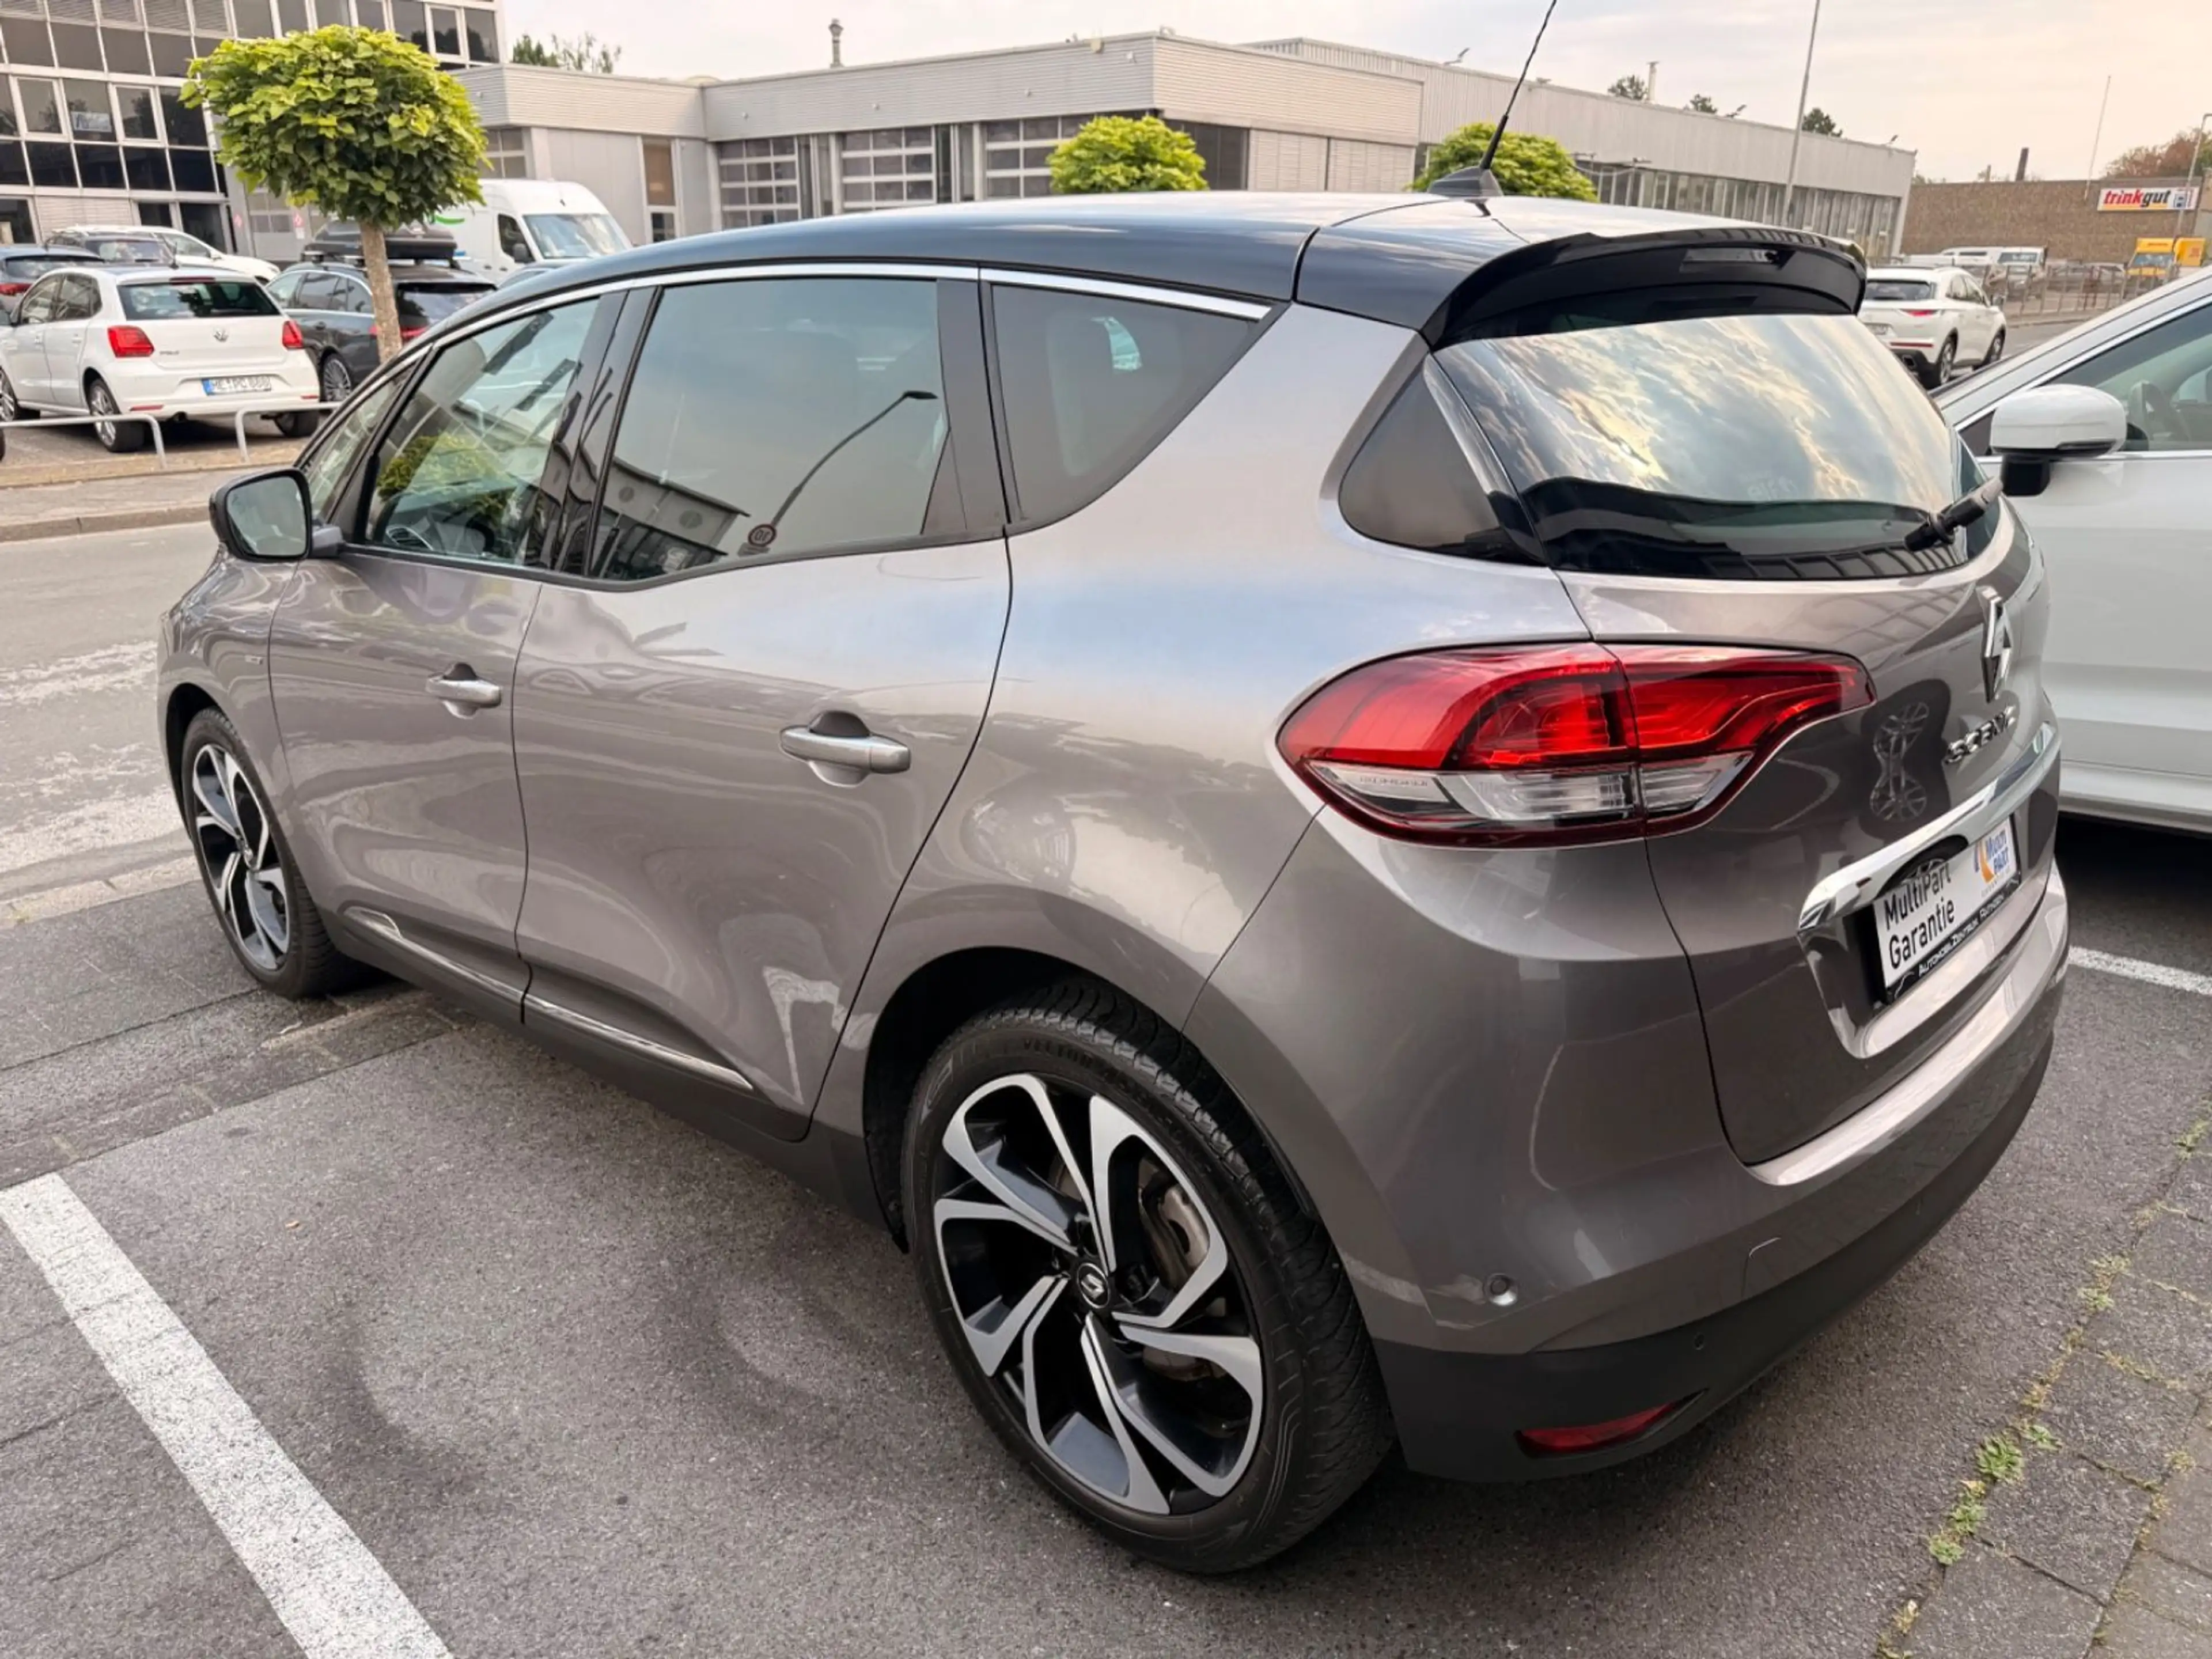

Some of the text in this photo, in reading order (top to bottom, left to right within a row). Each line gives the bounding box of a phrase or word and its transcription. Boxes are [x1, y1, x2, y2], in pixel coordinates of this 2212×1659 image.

[2103, 188, 2171, 207] trinkgut
[1884, 863, 1951, 930] MultiPart
[1889, 896, 1955, 969] Garantie
